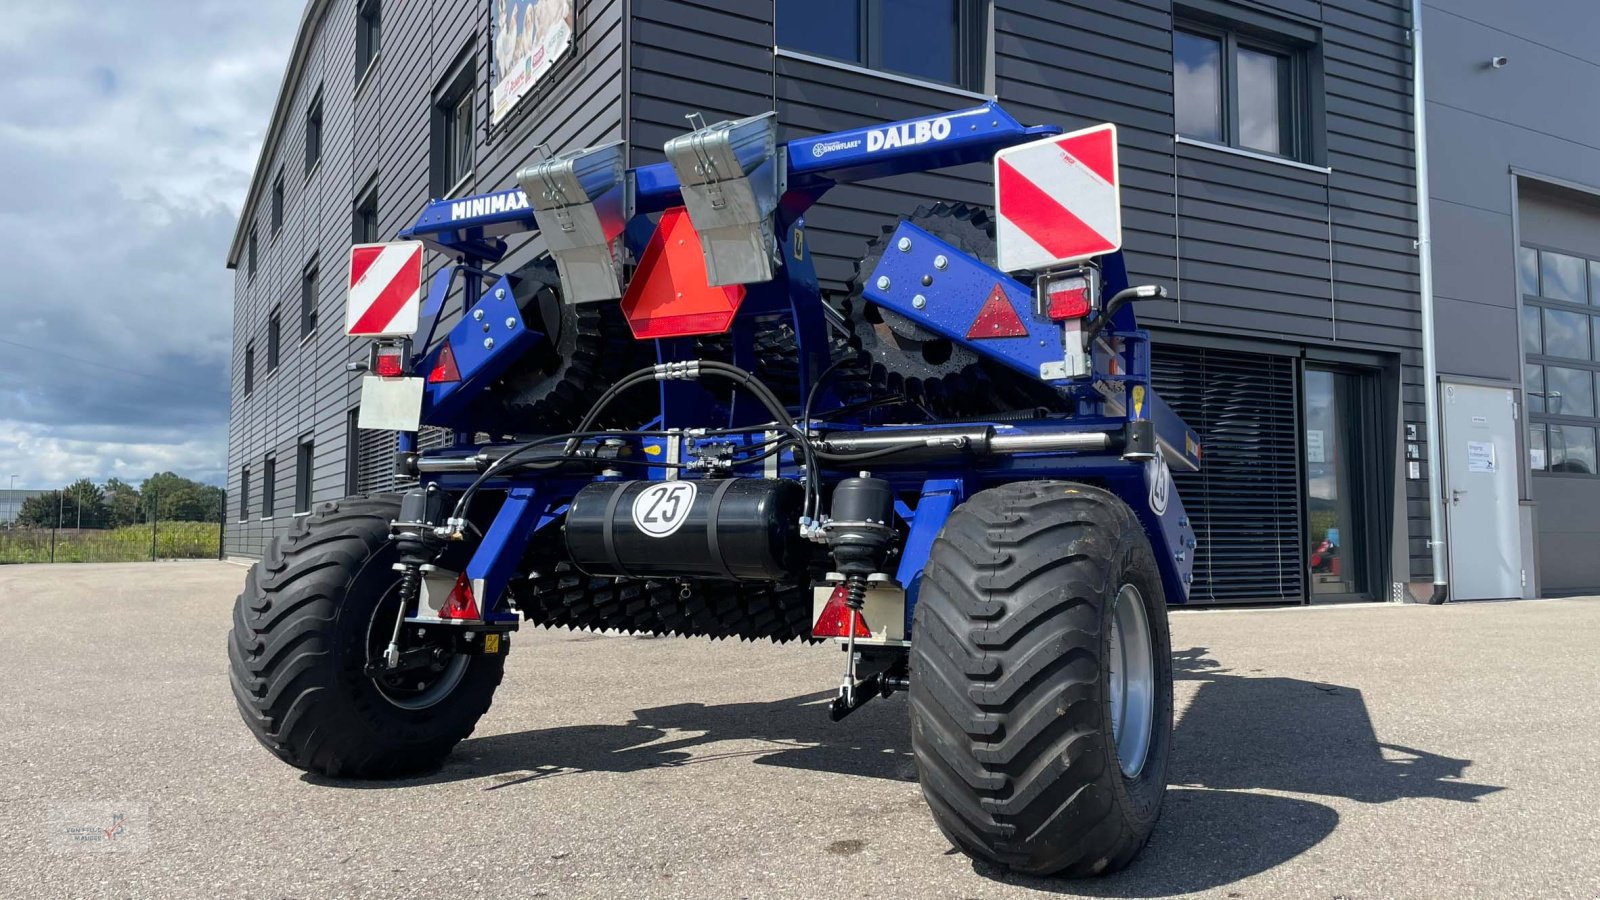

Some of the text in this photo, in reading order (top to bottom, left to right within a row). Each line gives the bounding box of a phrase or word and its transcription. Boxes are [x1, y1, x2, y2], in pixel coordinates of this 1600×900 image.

[866, 117, 951, 152] DALBO
[452, 191, 529, 220] MINIMAX
[643, 486, 687, 523] 25
